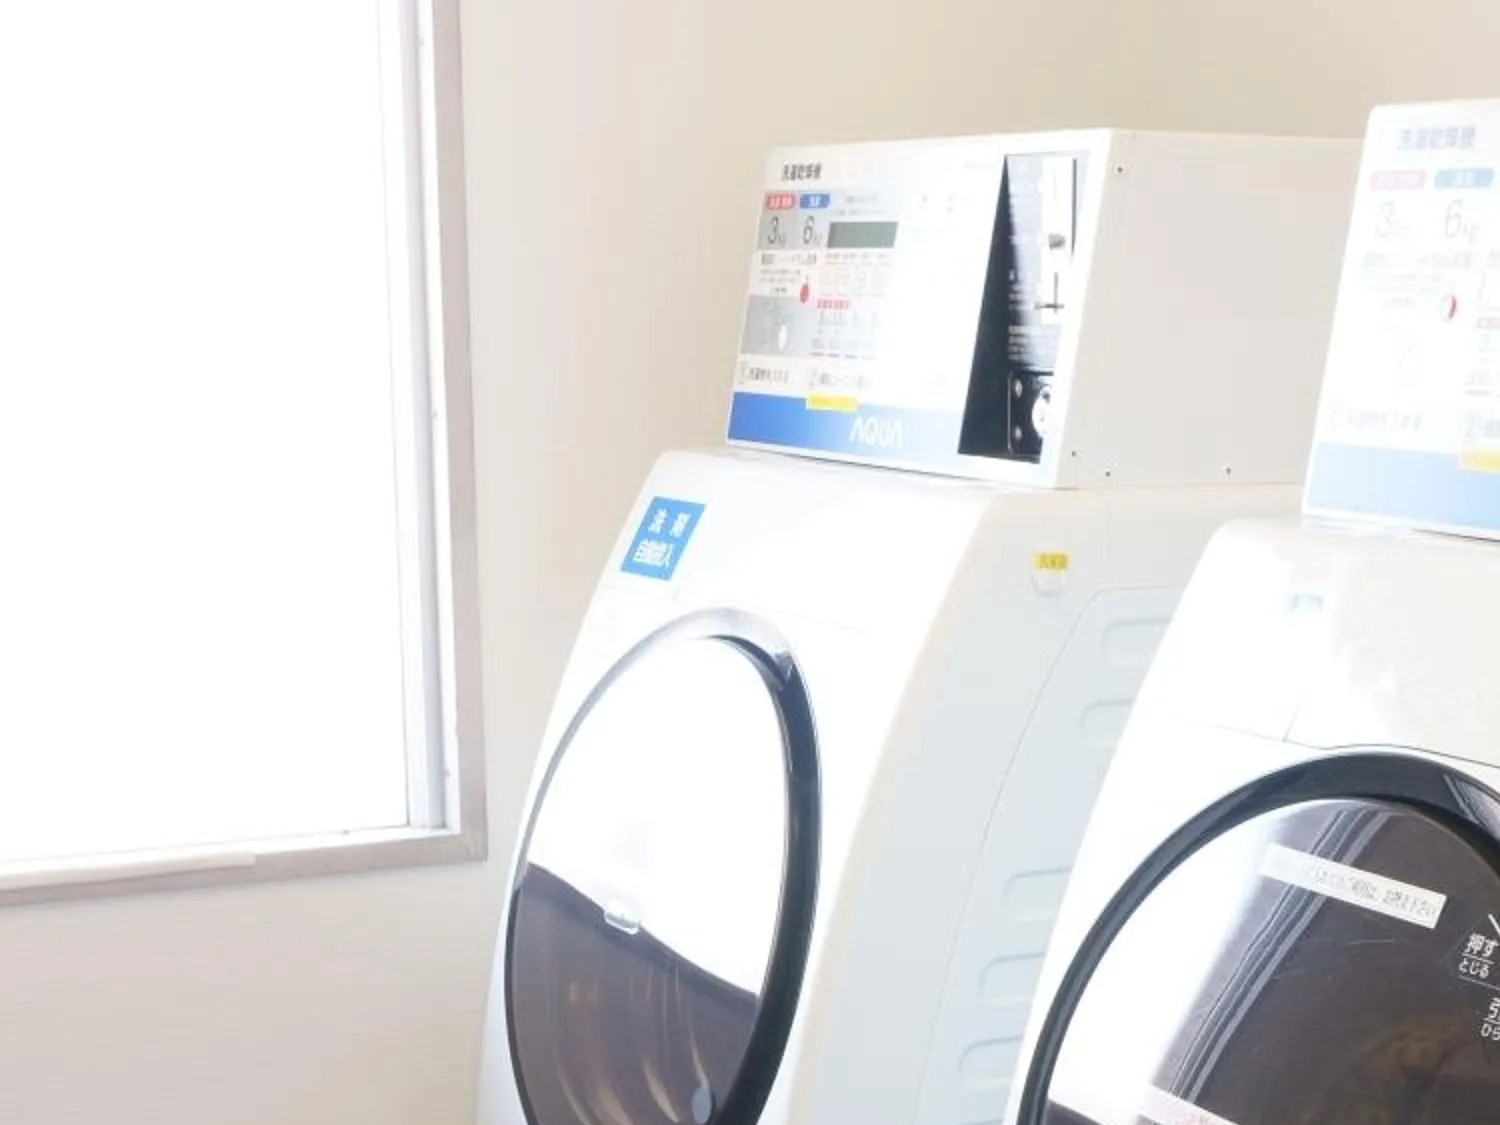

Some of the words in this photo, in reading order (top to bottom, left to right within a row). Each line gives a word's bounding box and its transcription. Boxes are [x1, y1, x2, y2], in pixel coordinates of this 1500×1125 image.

[850, 416, 903, 447] AQUA
[1467, 932, 1500, 958] 押す
[1459, 959, 1490, 979] とじる
